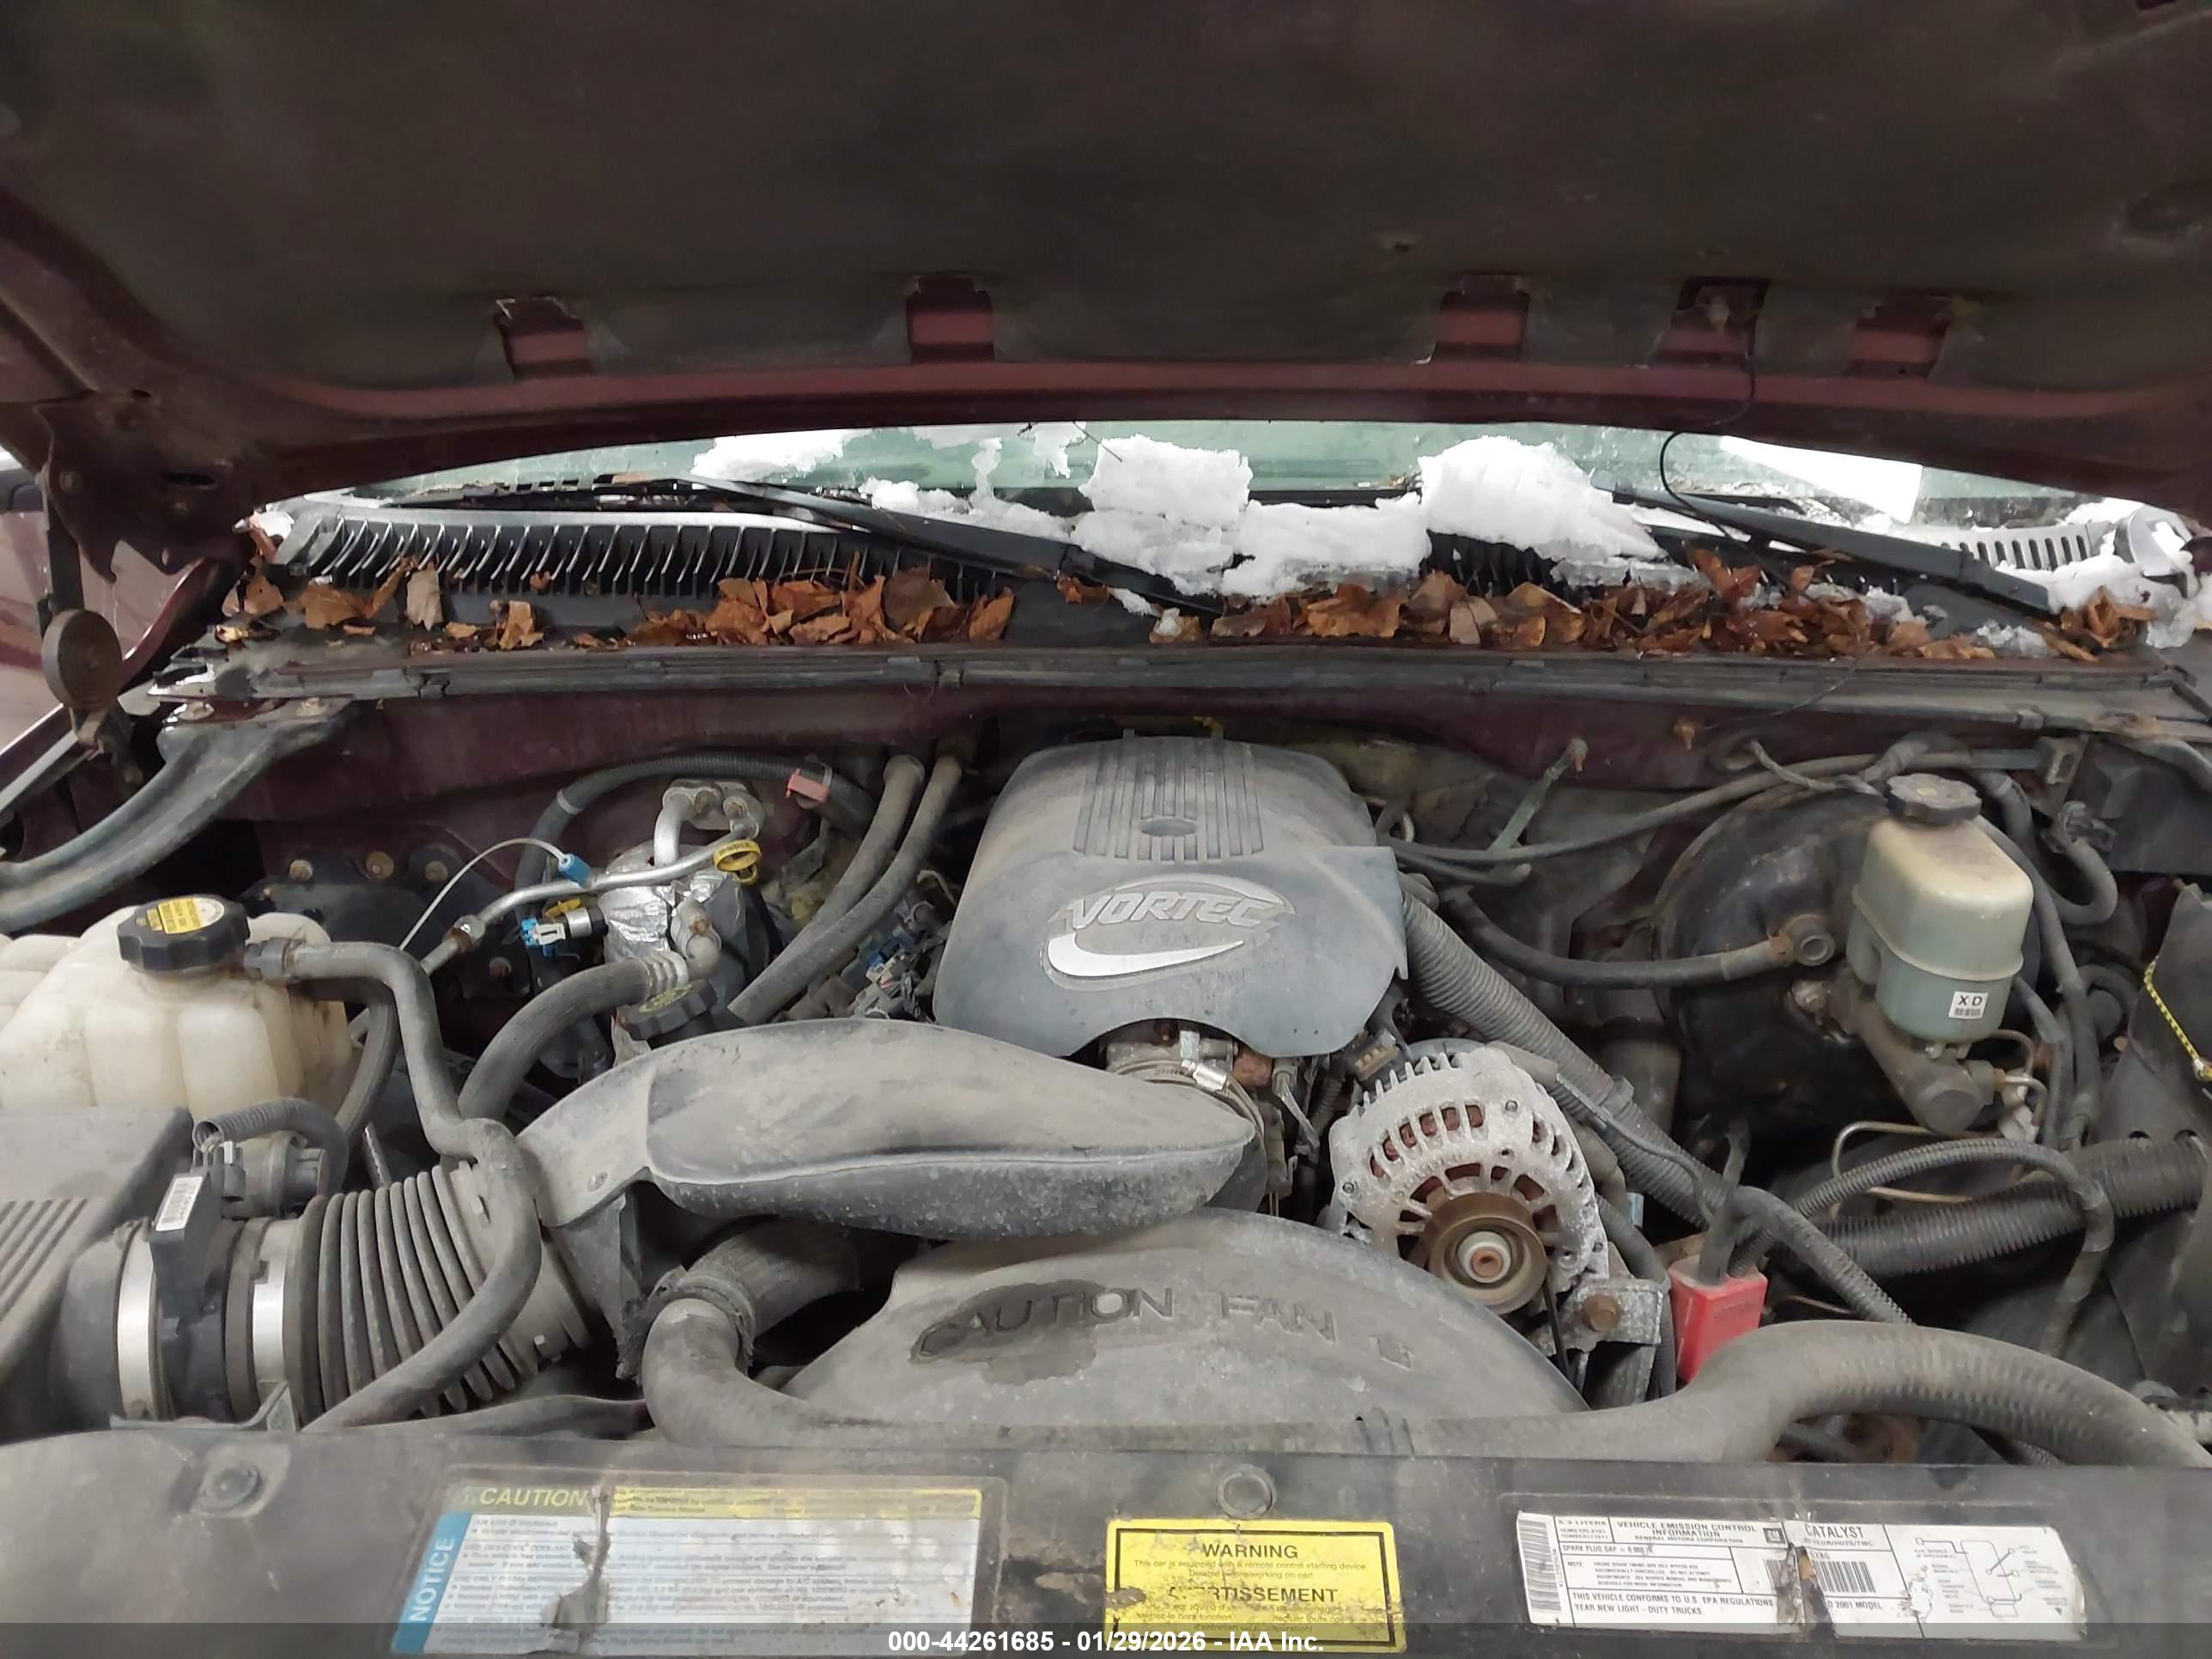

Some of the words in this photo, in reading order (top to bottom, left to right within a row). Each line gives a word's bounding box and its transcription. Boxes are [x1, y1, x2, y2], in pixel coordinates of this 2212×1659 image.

[1067, 890, 1276, 930] VORTEC
[912, 1286, 1173, 1362] CAUTION
[1219, 1291, 1338, 1344] FAN
[480, 1487, 587, 1507] CAUTION
[1616, 1521, 1656, 1529] VEHICLE
[1661, 1522, 1708, 1531] EMISSION
[1711, 1524, 1756, 1533] CONTROL
[1652, 1528, 1721, 1538] INFORMATION
[1804, 1524, 1864, 1539] CATALYST
[1202, 1543, 1298, 1559] WARNING
[409, 1537, 455, 1622] NOTICE
[1167, 1586, 1339, 1602] RTISSEMENT
[1572, 1592, 1590, 1601] THIS
[1591, 1593, 1624, 1601] VEHICLE
[1626, 1594, 1668, 1603] CONFORMS
[1670, 1595, 1681, 1603] TO
[1702, 1596, 1718, 1605] EPA
[1719, 1597, 1774, 1607] REGULATIONS
[1574, 1603, 1595, 1612] YEAR
[1617, 1605, 1639, 1613] LIGHT
[1648, 1606, 1668, 1614] DUTY
[1671, 1607, 1703, 1615] TRUCKS
[1834, 1601, 1853, 1609] 2001
[1855, 1601, 1882, 1610] MODEL
